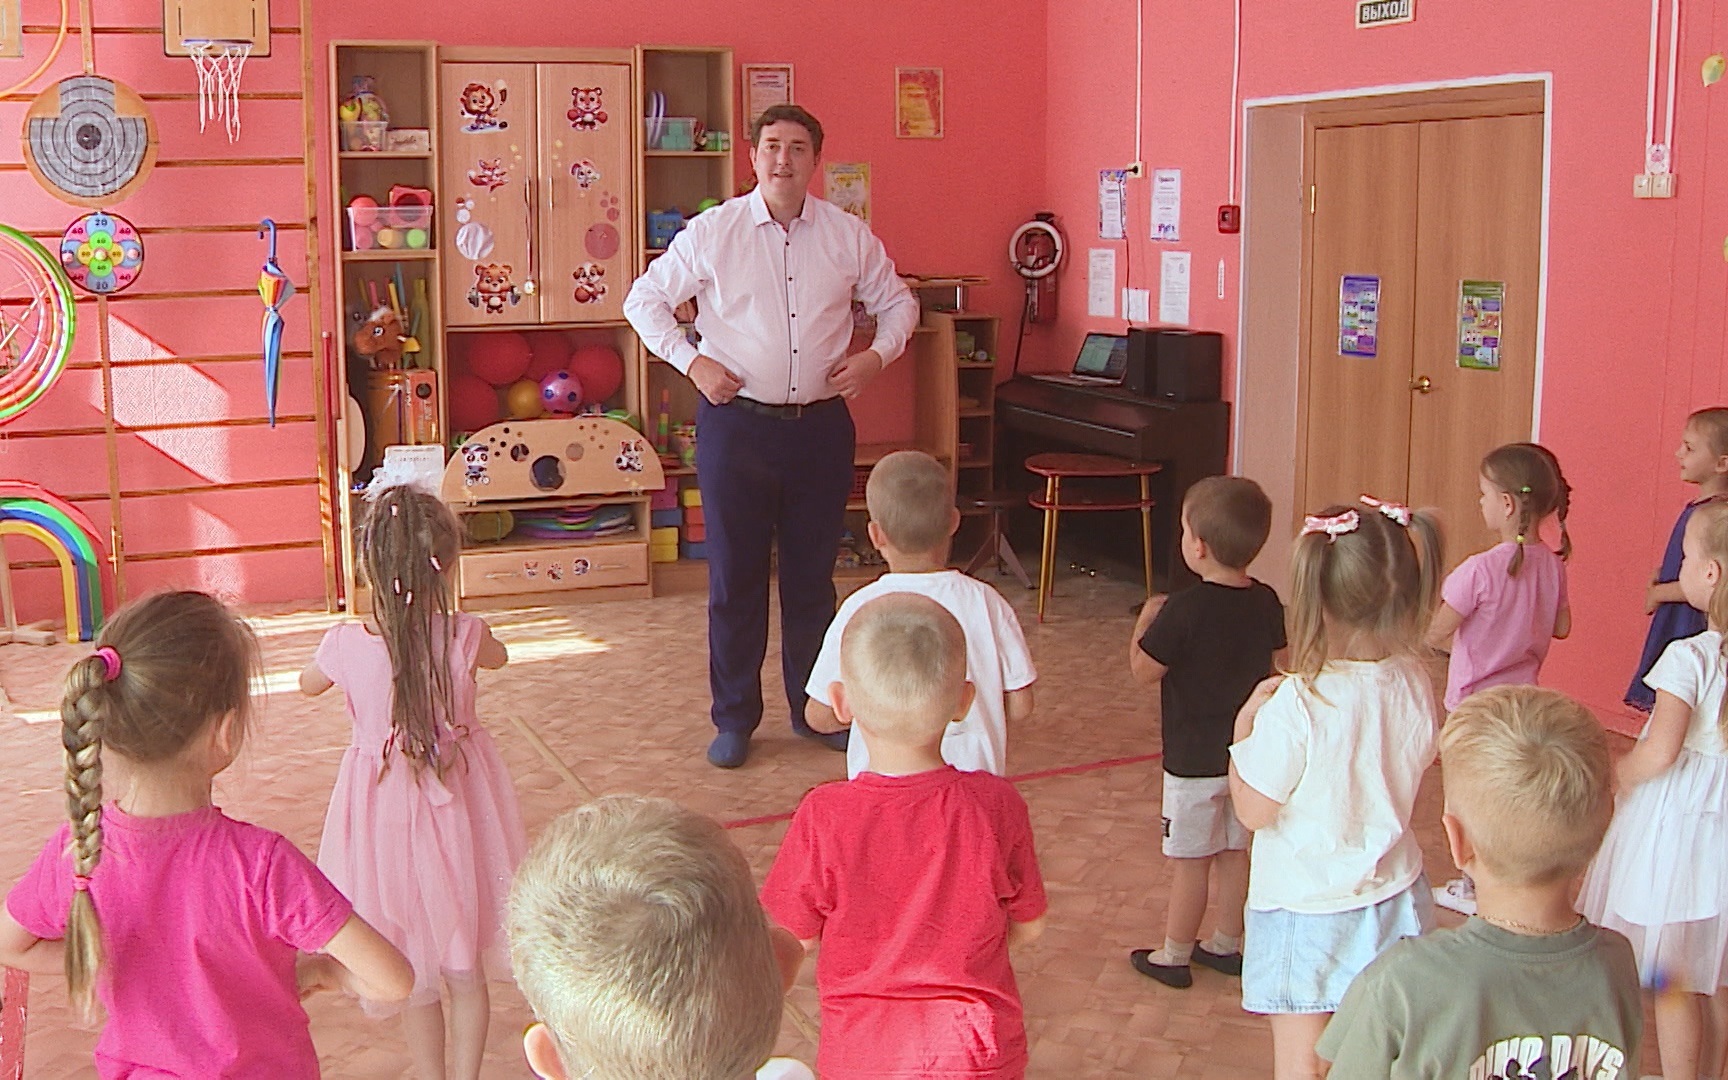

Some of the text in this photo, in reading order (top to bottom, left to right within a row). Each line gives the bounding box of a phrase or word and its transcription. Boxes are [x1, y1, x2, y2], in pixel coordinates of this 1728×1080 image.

[1362, 0, 1409, 22] ВЫХОД
[95, 218, 108, 226] 20
[1550, 1034, 1625, 1080] DAYS
